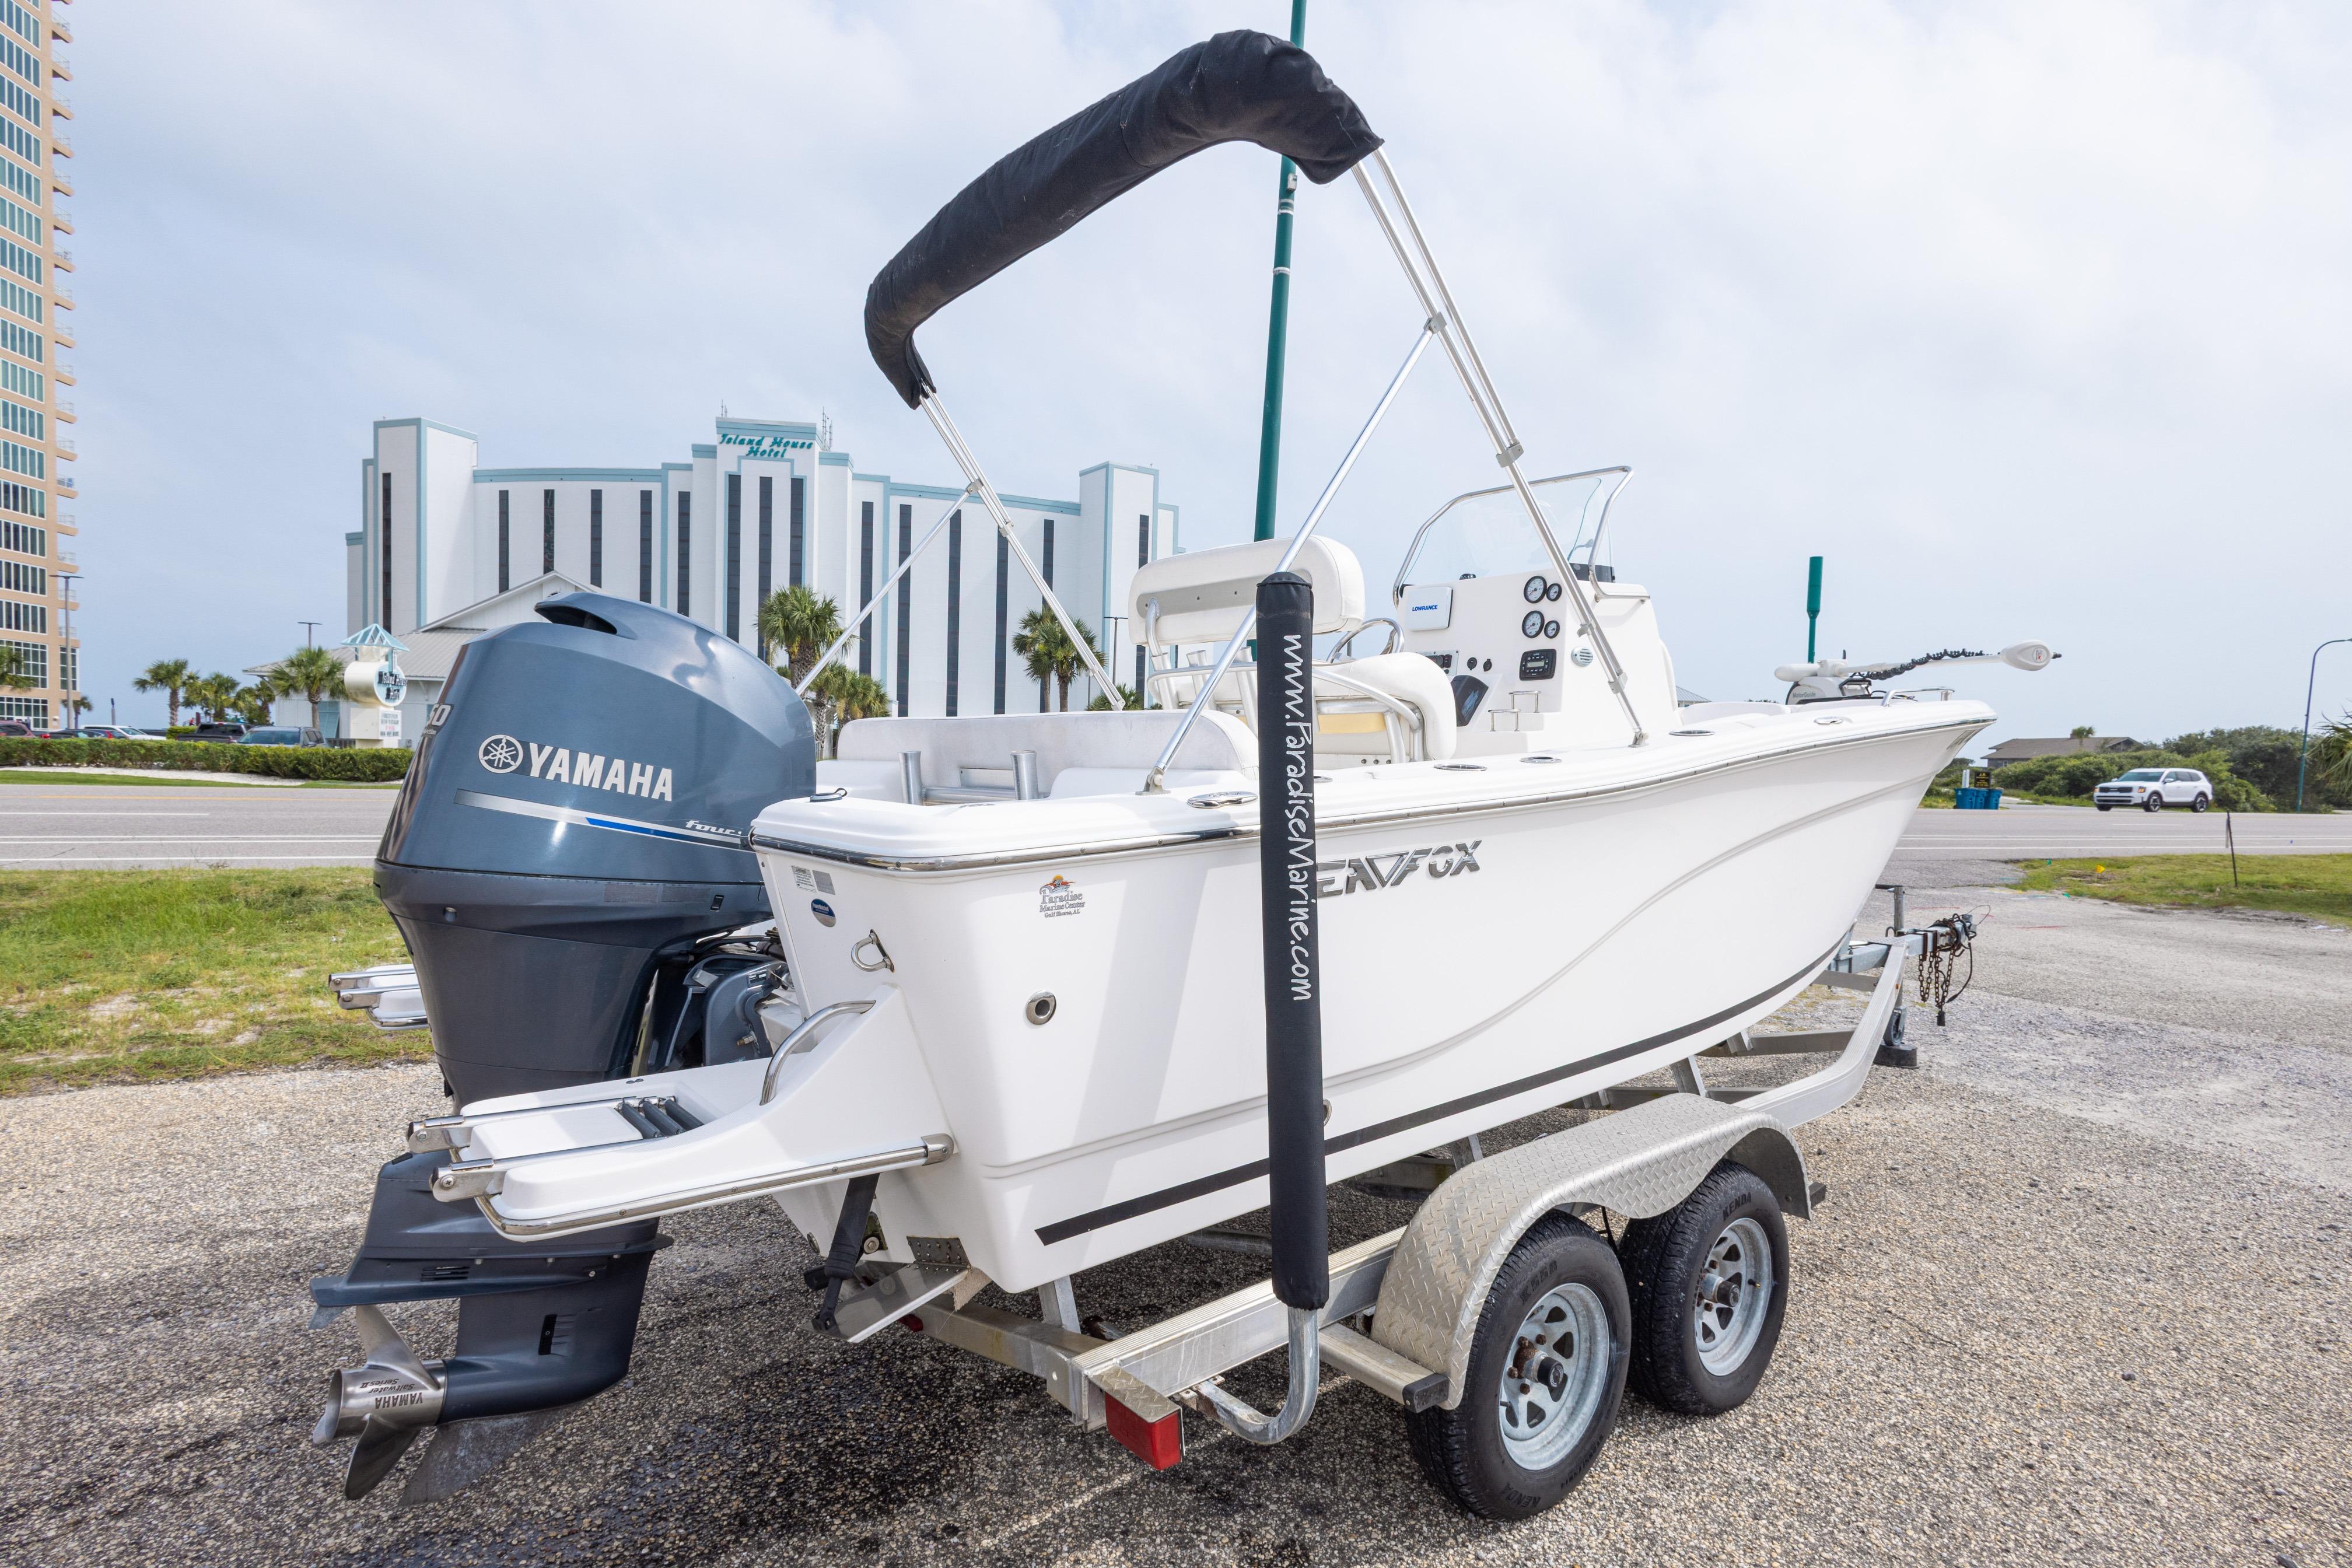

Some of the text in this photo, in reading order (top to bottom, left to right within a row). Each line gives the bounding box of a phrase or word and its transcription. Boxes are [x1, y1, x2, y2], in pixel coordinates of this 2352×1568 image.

[719, 434, 813, 449] Island House
[746, 446, 786, 457] Hotel
[529, 743, 672, 802] YAMAHA
[1283, 634, 1316, 1000] www.ParadiseMarine.com
[1040, 886, 1083, 905] Paradise
[1040, 903, 1065, 912] Marine
[1723, 1192, 1752, 1221] KENDA
[369, 1378, 399, 1387] Series
[369, 1384, 415, 1394] Saltwater
[375, 1392, 423, 1409] YAMAHA
